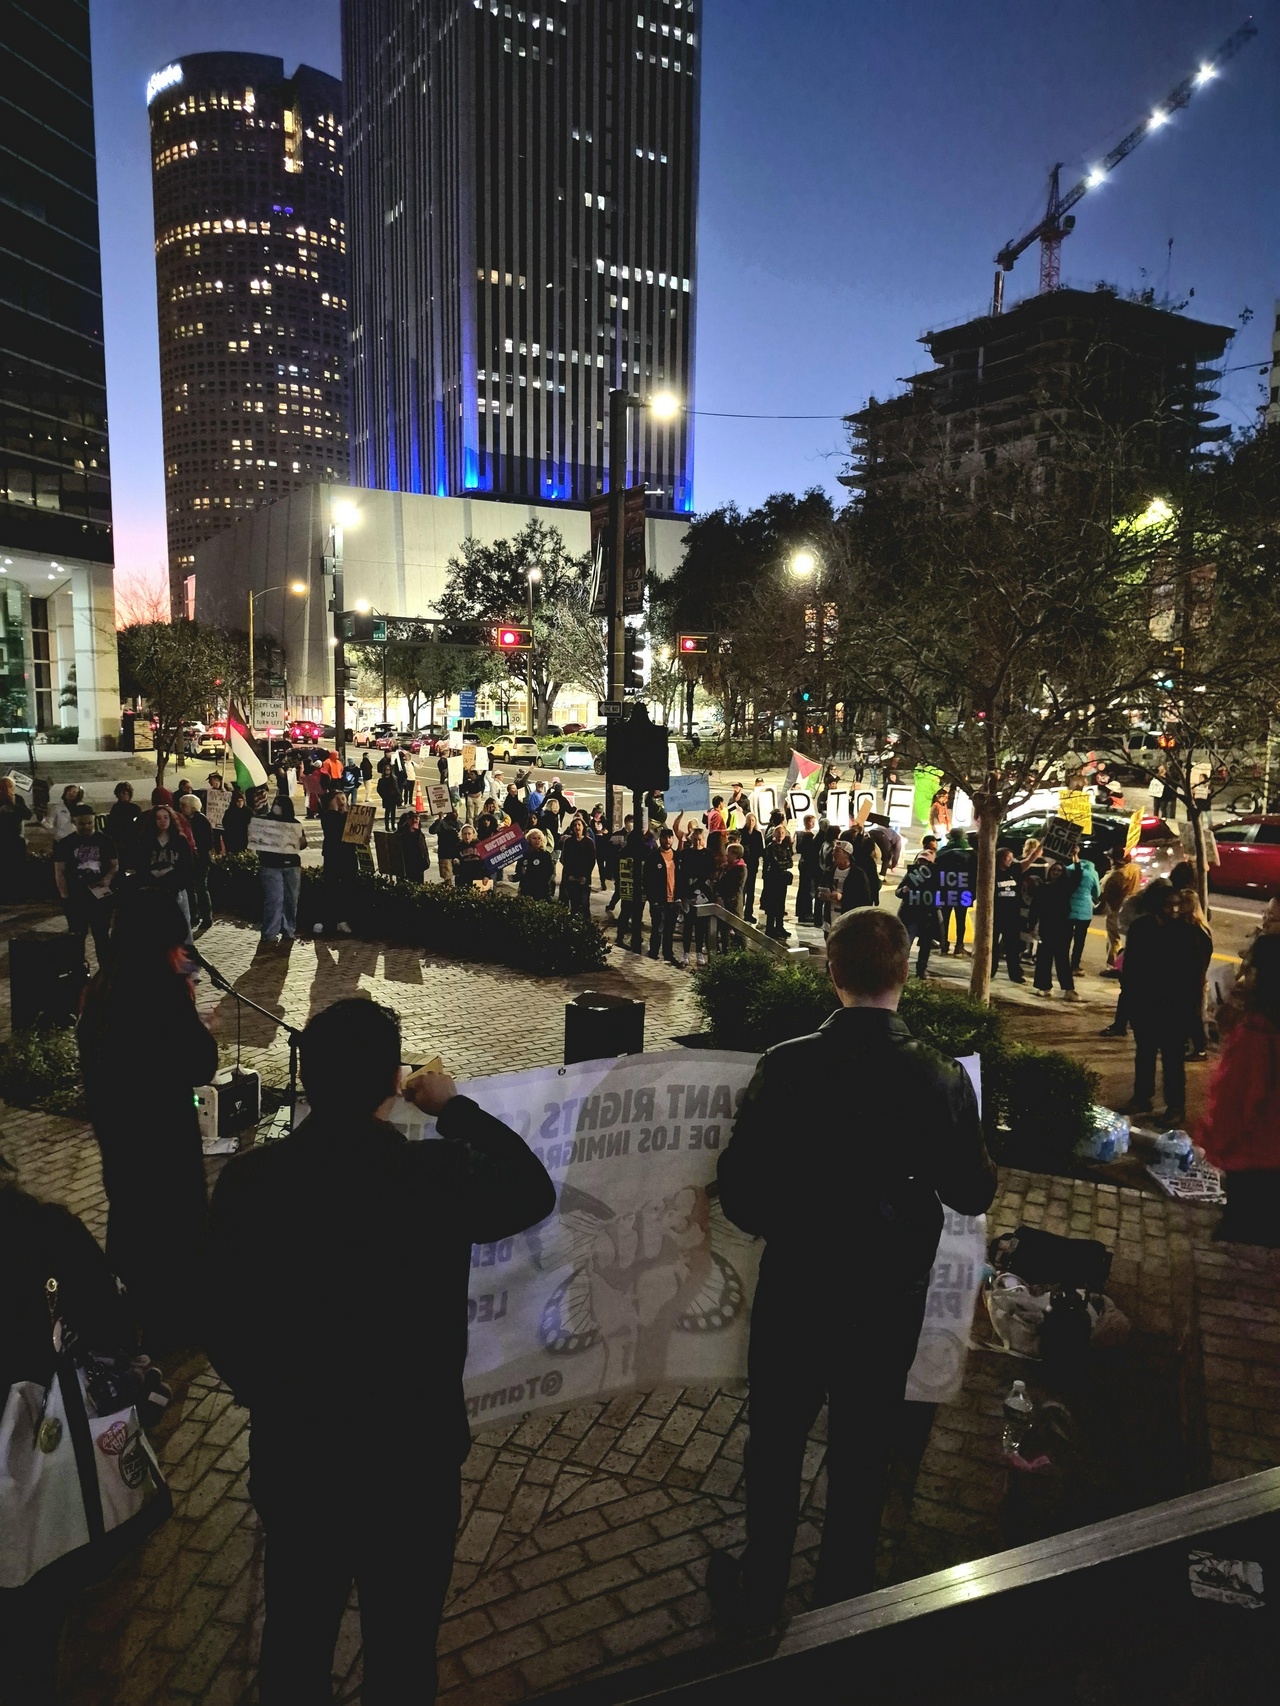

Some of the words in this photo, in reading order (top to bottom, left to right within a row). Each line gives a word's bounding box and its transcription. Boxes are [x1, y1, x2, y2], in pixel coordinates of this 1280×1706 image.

[350, 822, 368, 835] NOT
[1048, 825, 1078, 842] ICE
[484, 830, 516, 852] DICTATOR
[489, 843, 523, 866] DEMOCRACY
[908, 865, 932, 886] NO
[940, 870, 969, 888] ICE
[908, 890, 973, 907] HOLES
